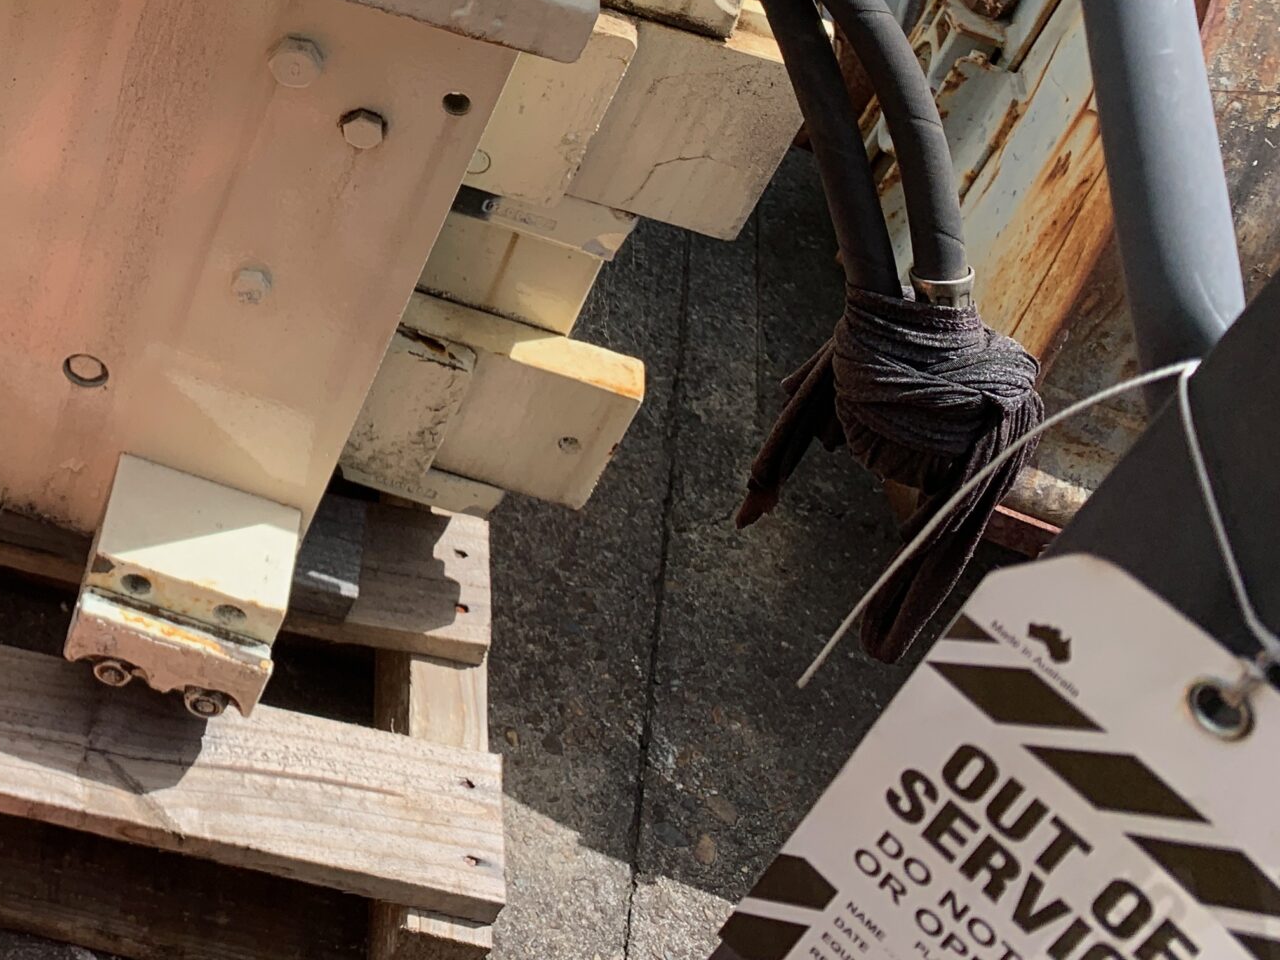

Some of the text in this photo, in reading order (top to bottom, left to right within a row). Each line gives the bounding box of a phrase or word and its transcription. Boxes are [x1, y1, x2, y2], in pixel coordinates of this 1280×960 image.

[991, 621, 1080, 698] Made in Australia
[941, 743, 1094, 875] OUT
[876, 830, 931, 886] DO
[846, 901, 886, 942] NAME
[854, 849, 979, 960] OR OP
[821, 932, 855, 960] EQU
[833, 917, 869, 953] DATE
